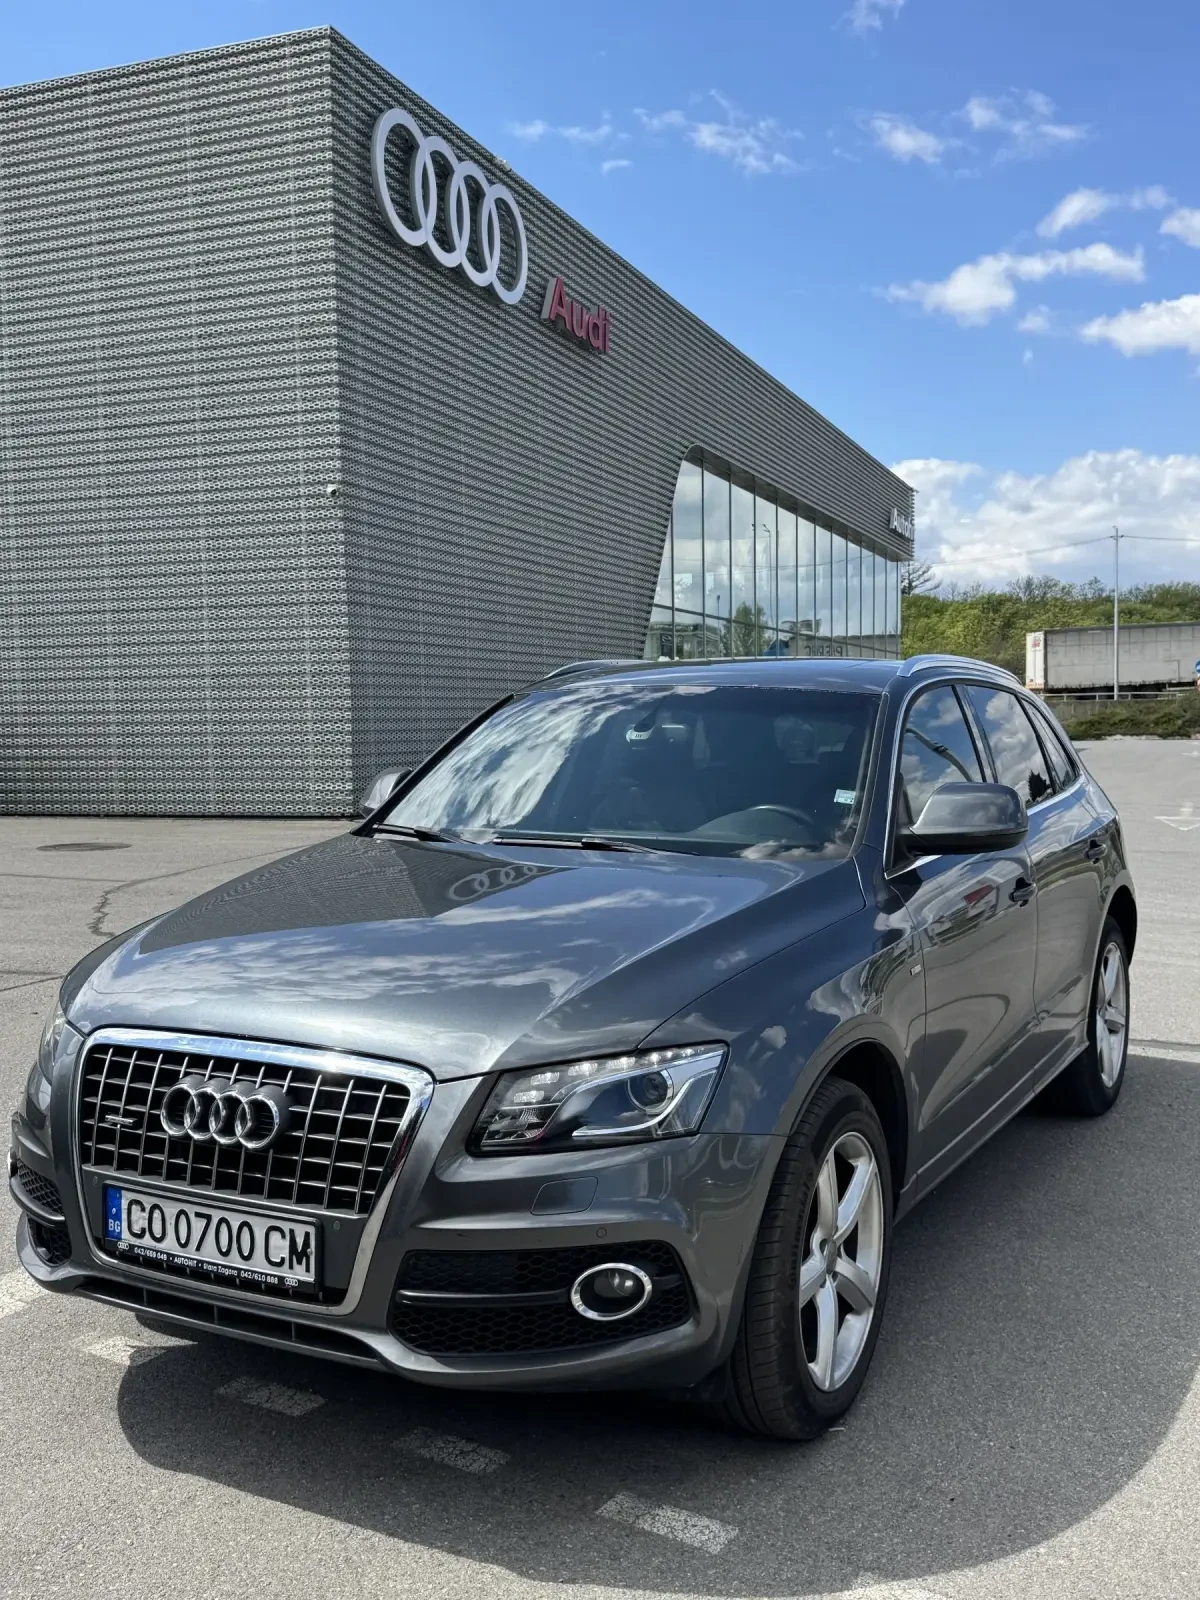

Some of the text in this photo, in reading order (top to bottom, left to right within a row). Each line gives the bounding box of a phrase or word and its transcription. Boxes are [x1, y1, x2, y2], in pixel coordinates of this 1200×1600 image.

[542, 276, 610, 353] Audi
[108, 1218, 121, 1233] BG
[127, 1198, 311, 1273] CO 0700 CM
[240, 1272, 266, 1282] 042/610
